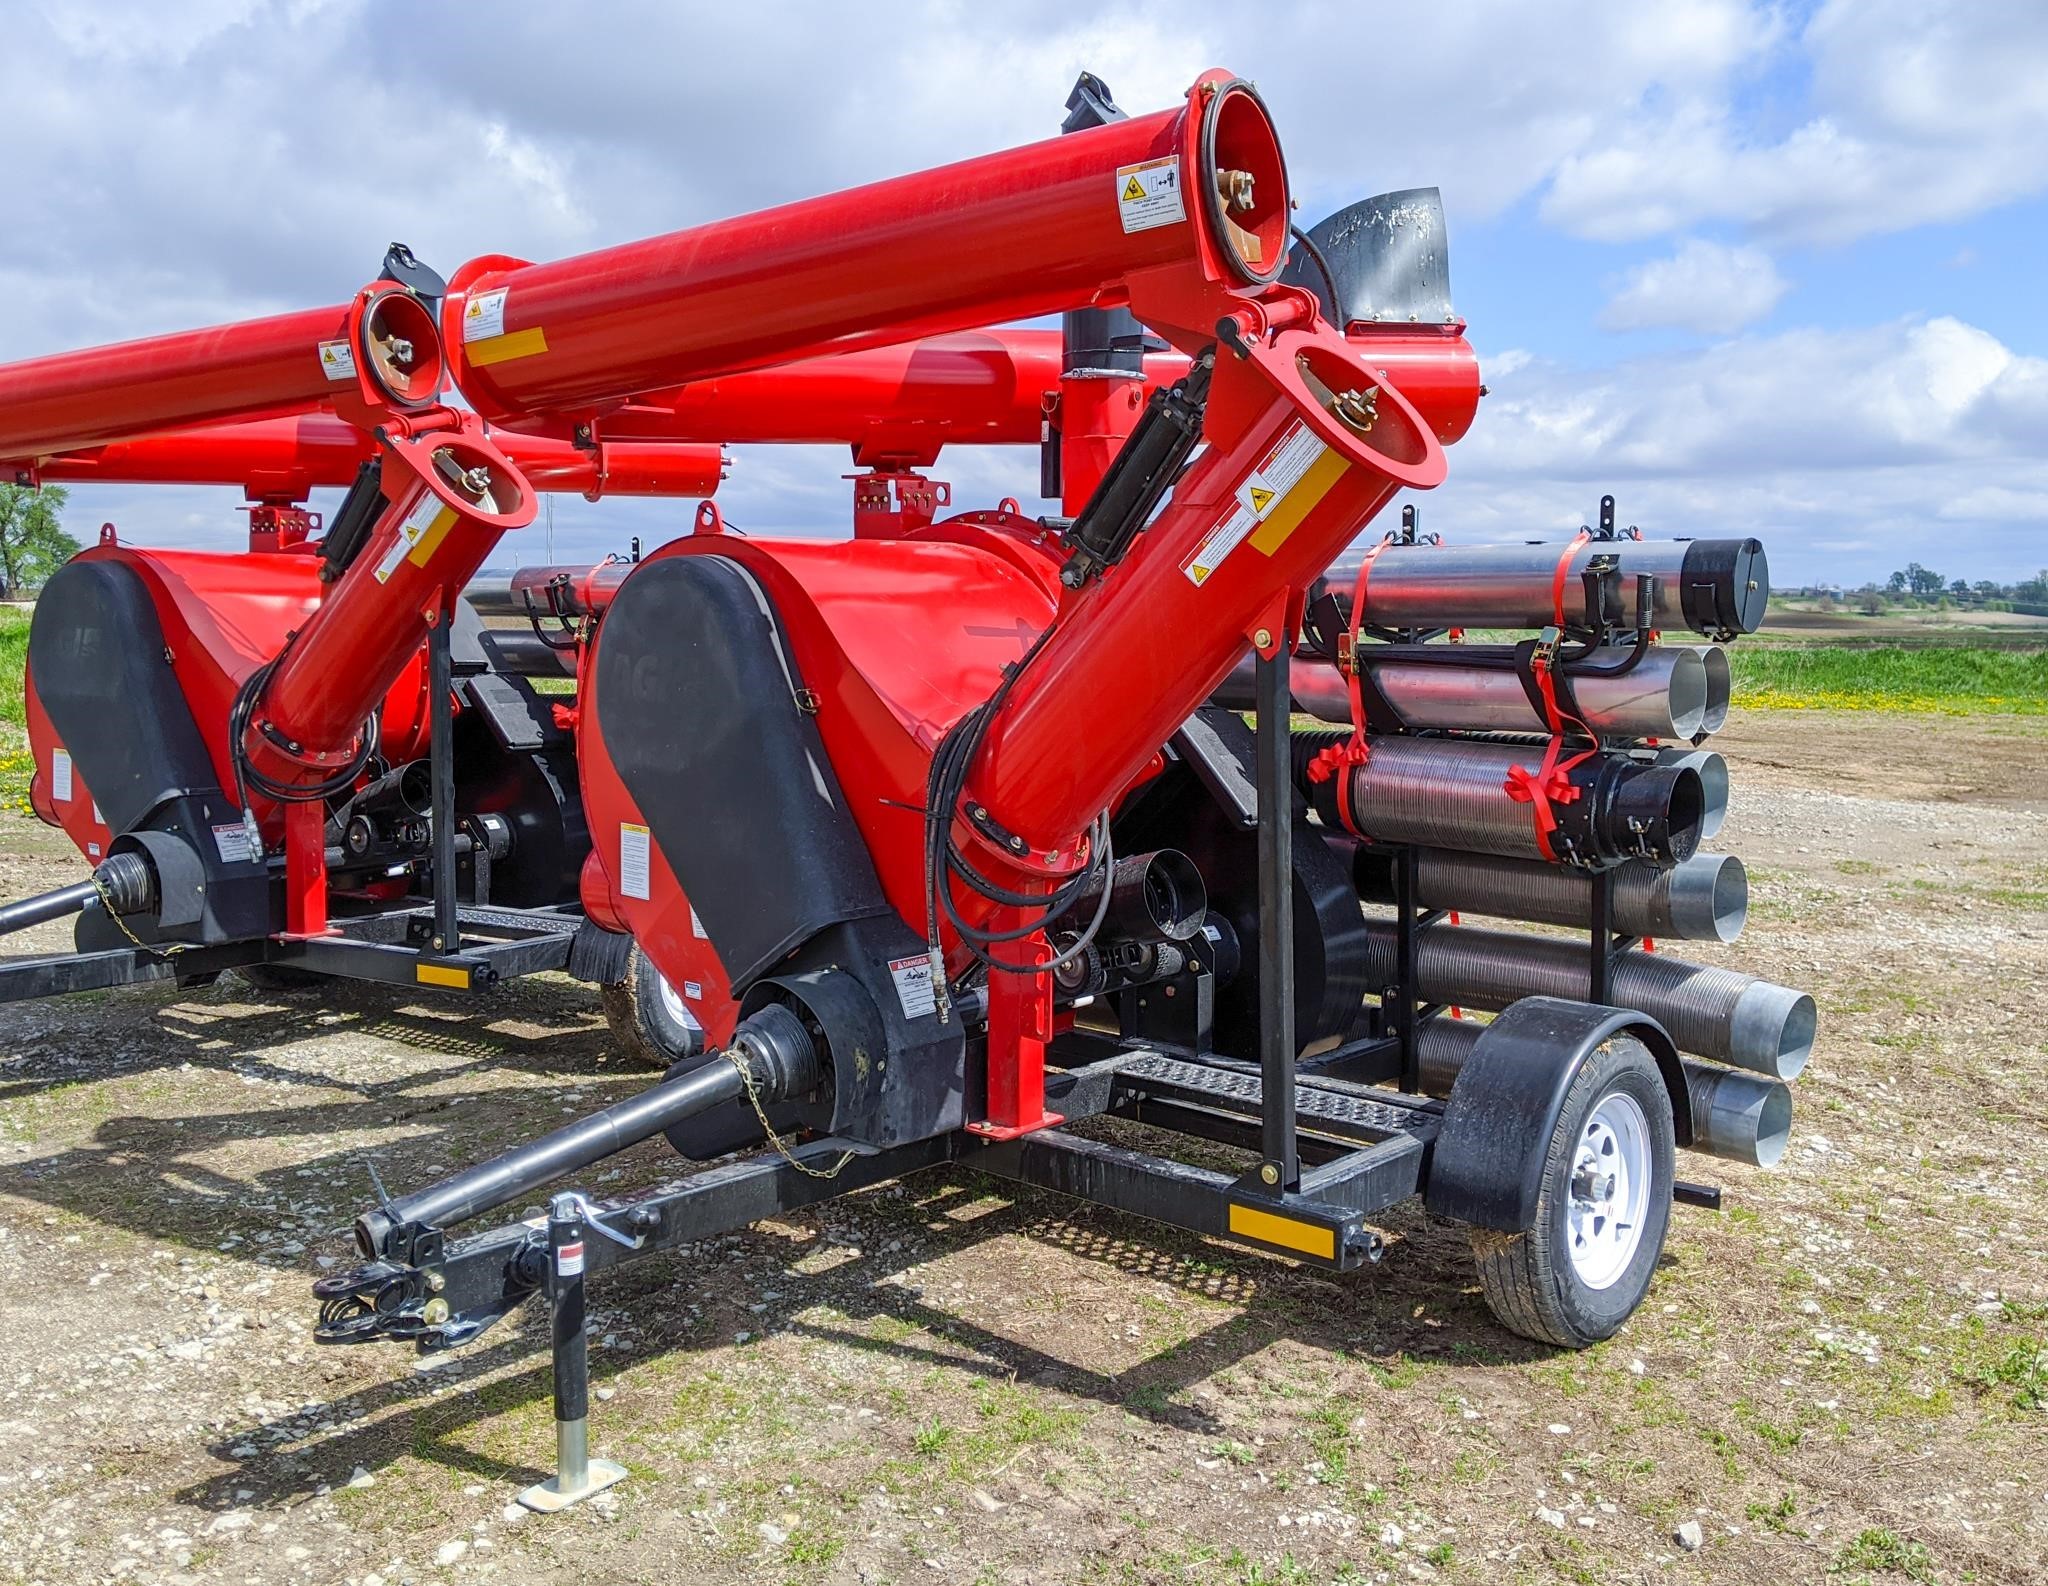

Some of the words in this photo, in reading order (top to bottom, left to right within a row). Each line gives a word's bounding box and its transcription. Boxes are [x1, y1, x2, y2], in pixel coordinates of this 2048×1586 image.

[1273, 435, 1291, 455] DANGER
[1204, 524, 1221, 543] DANGER
[902, 957, 928, 968] DANGER
